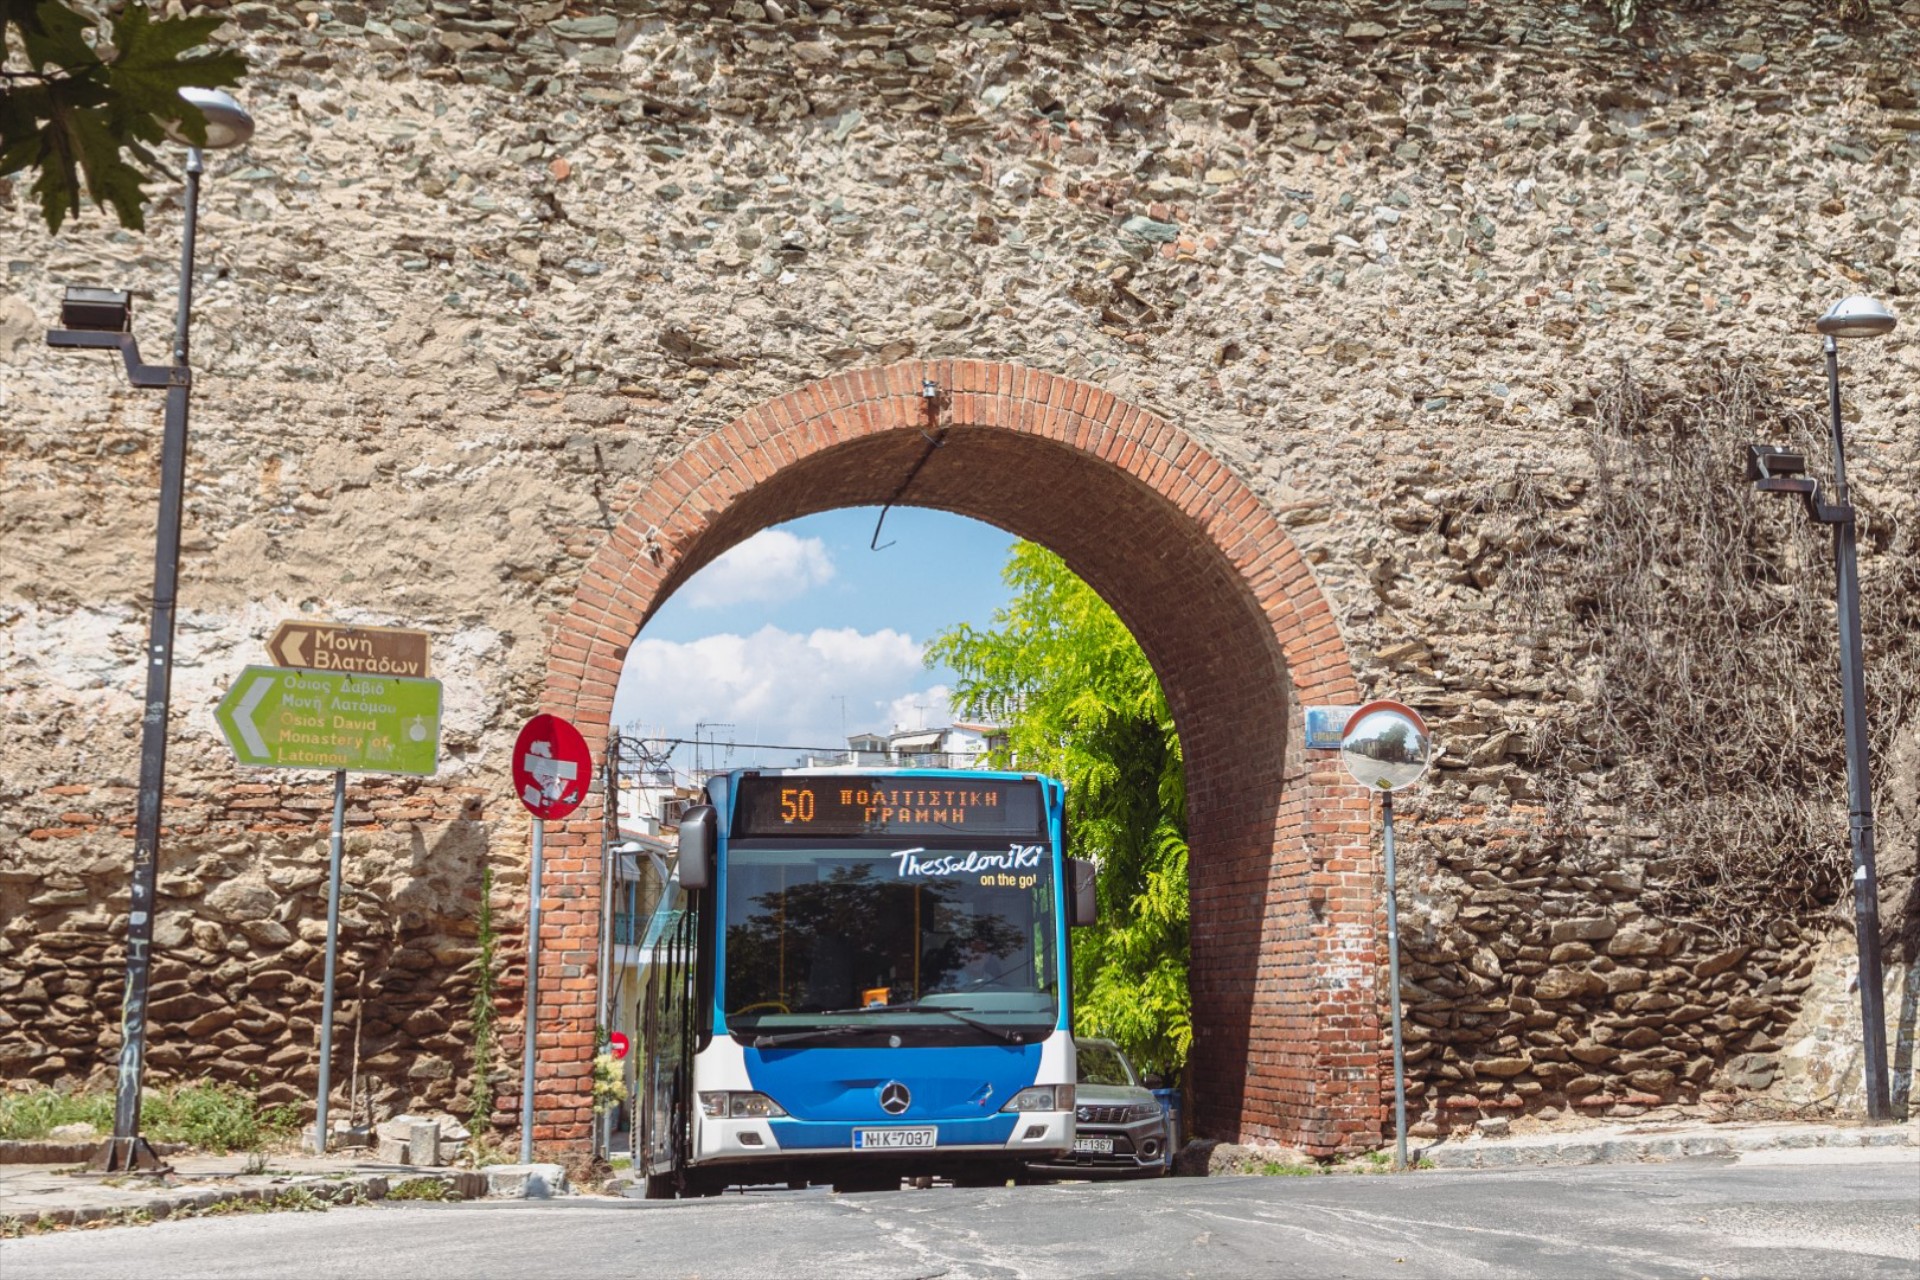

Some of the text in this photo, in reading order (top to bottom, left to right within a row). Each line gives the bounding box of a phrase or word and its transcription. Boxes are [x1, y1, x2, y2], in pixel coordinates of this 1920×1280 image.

[315, 629, 372, 656] Μονή
[314, 650, 418, 674] Βλατάδων
[280, 711, 376, 731] Osios David
[279, 729, 389, 749] Monastery of
[278, 747, 347, 764] Latomou
[781, 789, 814, 822] 50
[840, 789, 998, 806] ΠΟΛΙΤΙΣΤΙΚΗ
[865, 807, 964, 823] ΓΡΑΜΜΗ
[980, 873, 1036, 889] on the go!
